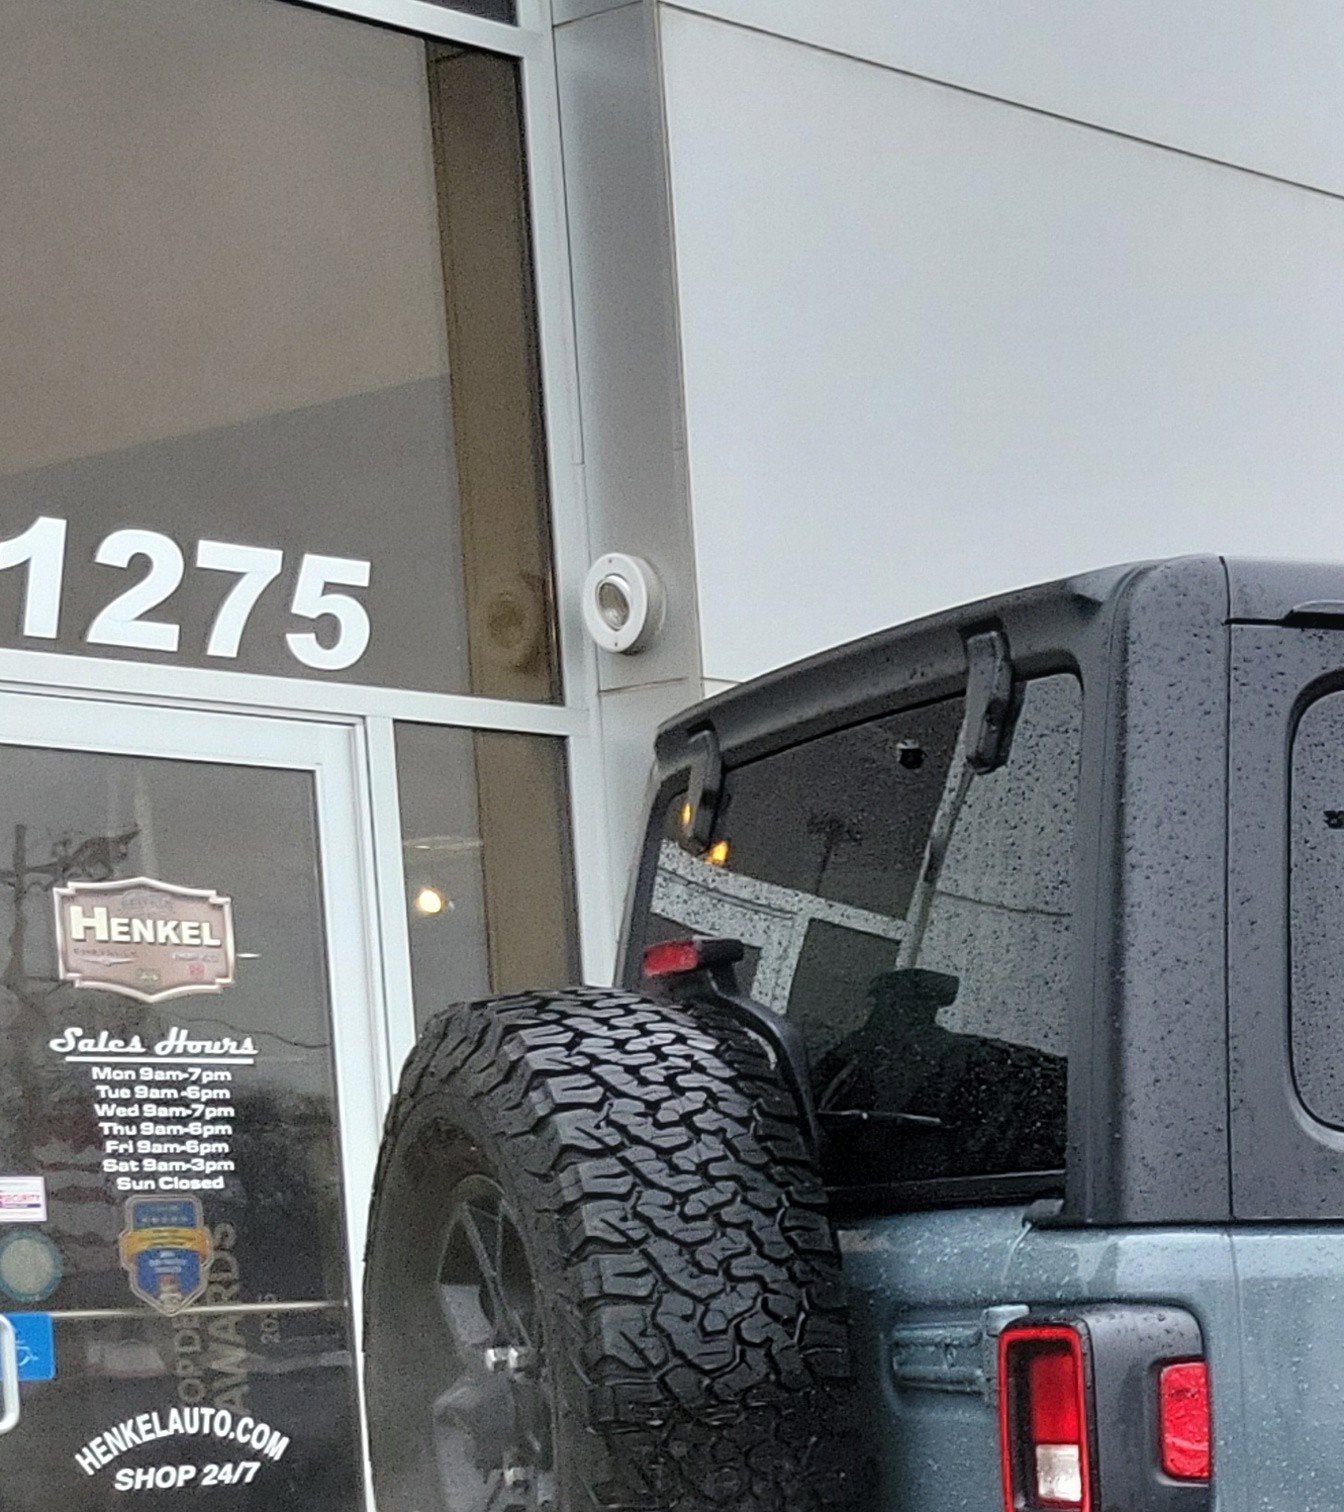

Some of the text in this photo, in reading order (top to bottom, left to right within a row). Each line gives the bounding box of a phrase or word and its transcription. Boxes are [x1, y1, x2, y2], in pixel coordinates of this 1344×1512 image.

[0, 515, 371, 671] 1275
[69, 905, 222, 947] HENKEL
[49, 1026, 259, 1056] Sales Hours
[91, 1066, 233, 1084] Mon 9am-7pm
[95, 1084, 132, 1099] Tue
[93, 1103, 236, 1121] Wed 9am-7pm
[98, 1121, 234, 1139] Thu 9am-6pm
[105, 1139, 230, 1156] Fri 9am-6pm
[102, 1157, 236, 1175] Sat 9am-3pm
[115, 1175, 226, 1191] Sun Closed
[74, 1405, 291, 1476] HENKELAUTO.COM
[113, 1461, 261, 1492] SHOP 24/7
